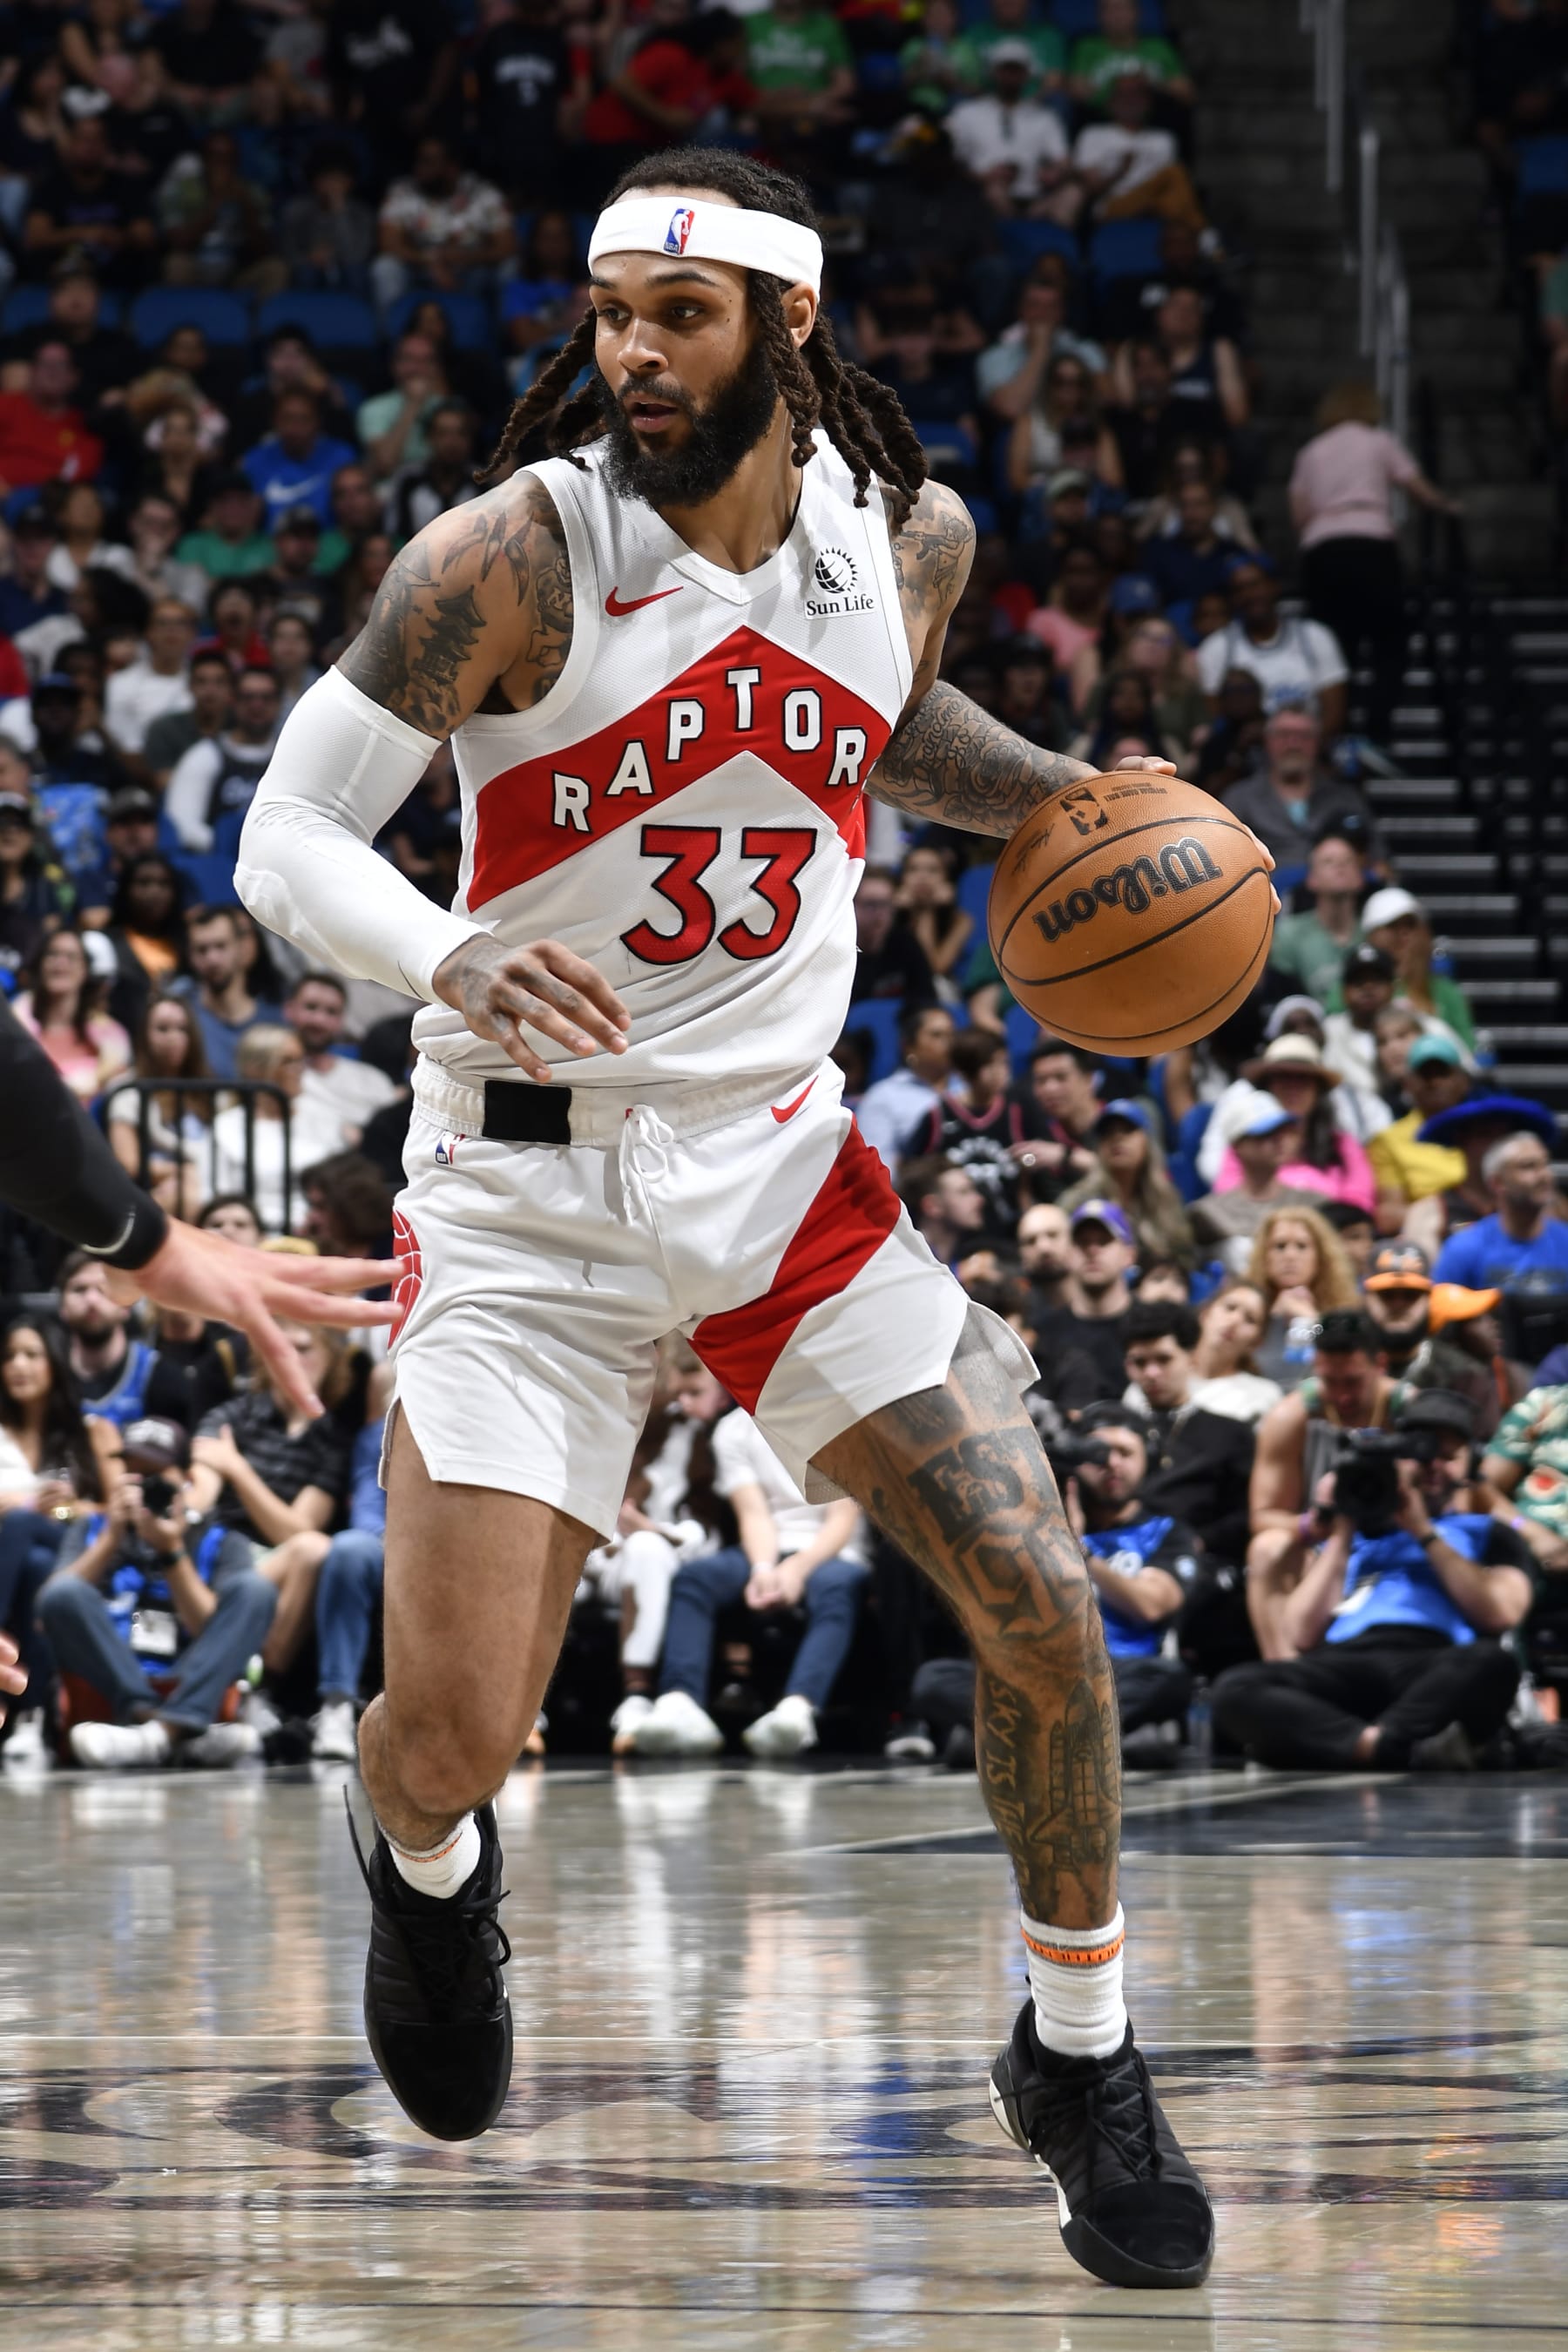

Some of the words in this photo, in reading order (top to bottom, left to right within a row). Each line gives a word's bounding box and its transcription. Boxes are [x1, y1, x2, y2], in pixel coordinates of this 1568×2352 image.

[807, 599, 841, 616] Sun
[842, 593, 875, 612] Life
[552, 666, 877, 834] RAPTOR
[619, 824, 818, 966] 33
[1031, 835, 1223, 943] Wilson
